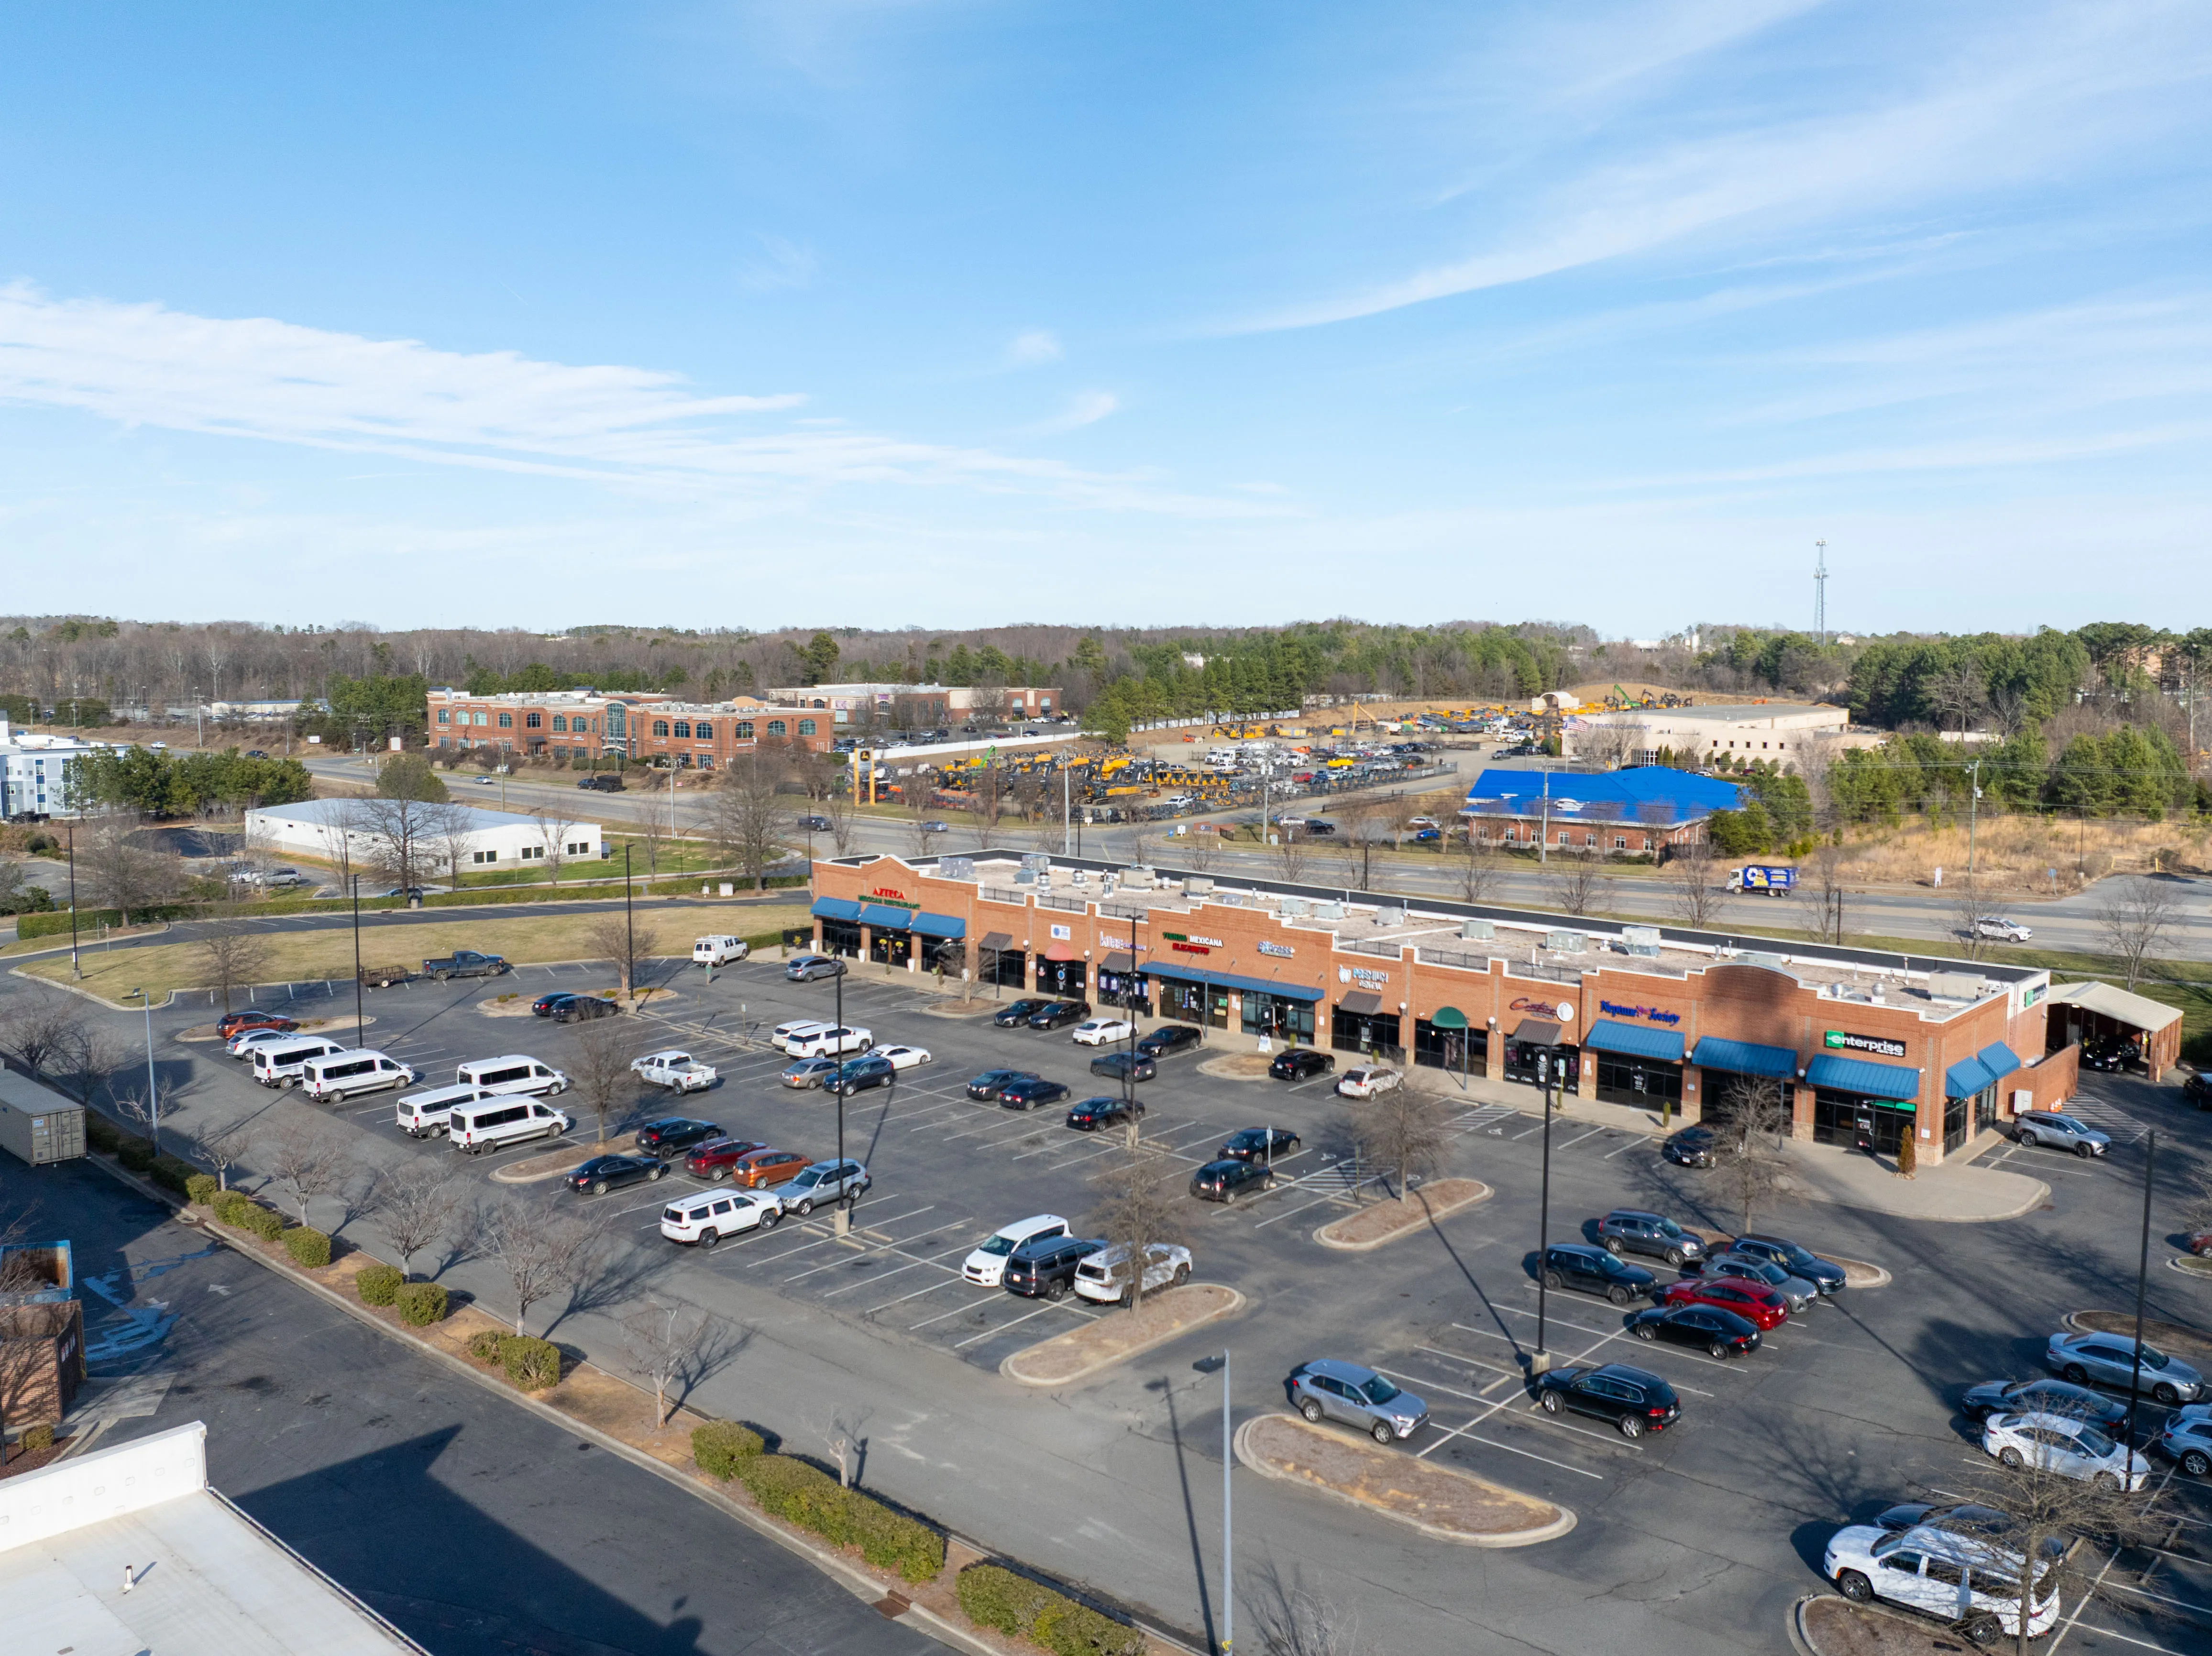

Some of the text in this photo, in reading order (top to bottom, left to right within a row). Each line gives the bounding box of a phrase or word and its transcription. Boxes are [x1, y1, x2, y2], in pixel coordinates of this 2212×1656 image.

[873, 887, 906, 900] AZTECA
[1163, 932, 1223, 947] TIENDA MEXICANA
[1352, 967, 1389, 984] PREMIUM
[1600, 1000, 1680, 1027] Neptune Society
[1828, 1034, 1904, 1053] enterprise
